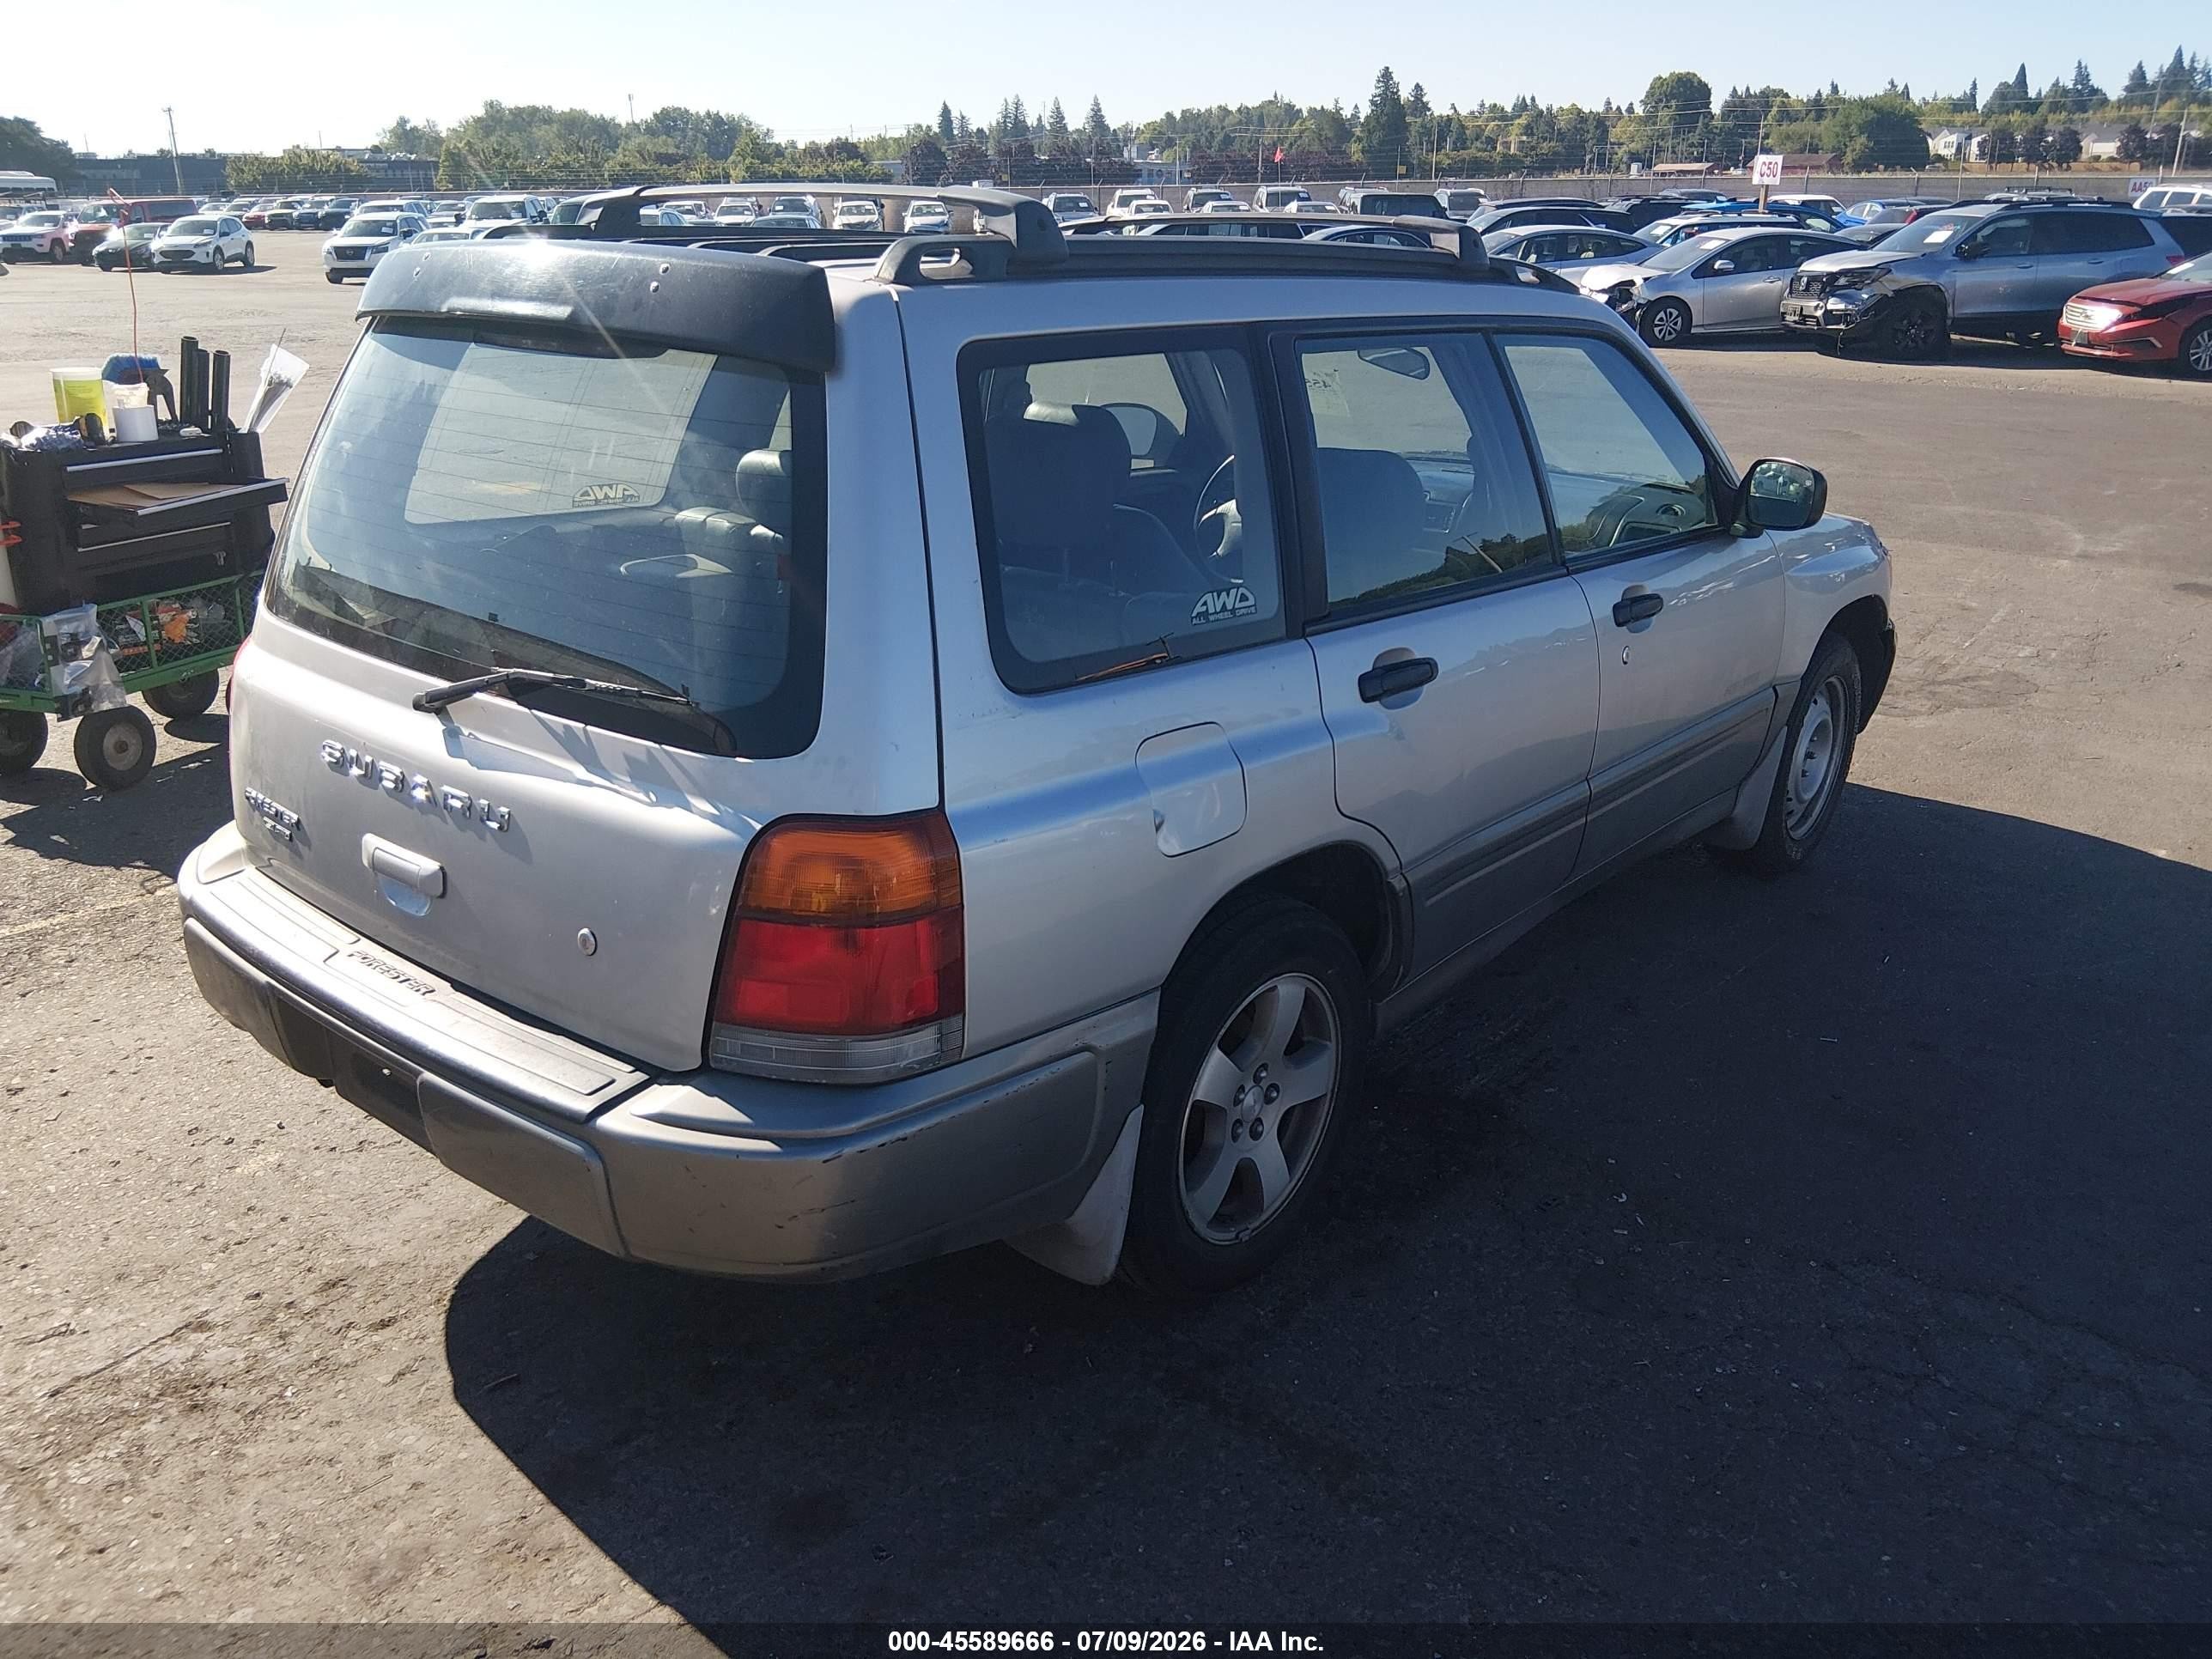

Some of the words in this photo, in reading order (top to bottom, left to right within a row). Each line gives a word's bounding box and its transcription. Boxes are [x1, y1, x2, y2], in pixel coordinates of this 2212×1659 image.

[1759, 161, 1778, 178] C50
[1191, 586, 1255, 617] AWD
[1192, 617, 1206, 625] ALL
[1209, 611, 1234, 622] WHEEL
[1237, 605, 1256, 616] DRIVE
[321, 738, 511, 833] SUBARU
[347, 950, 436, 996] FORESTER
